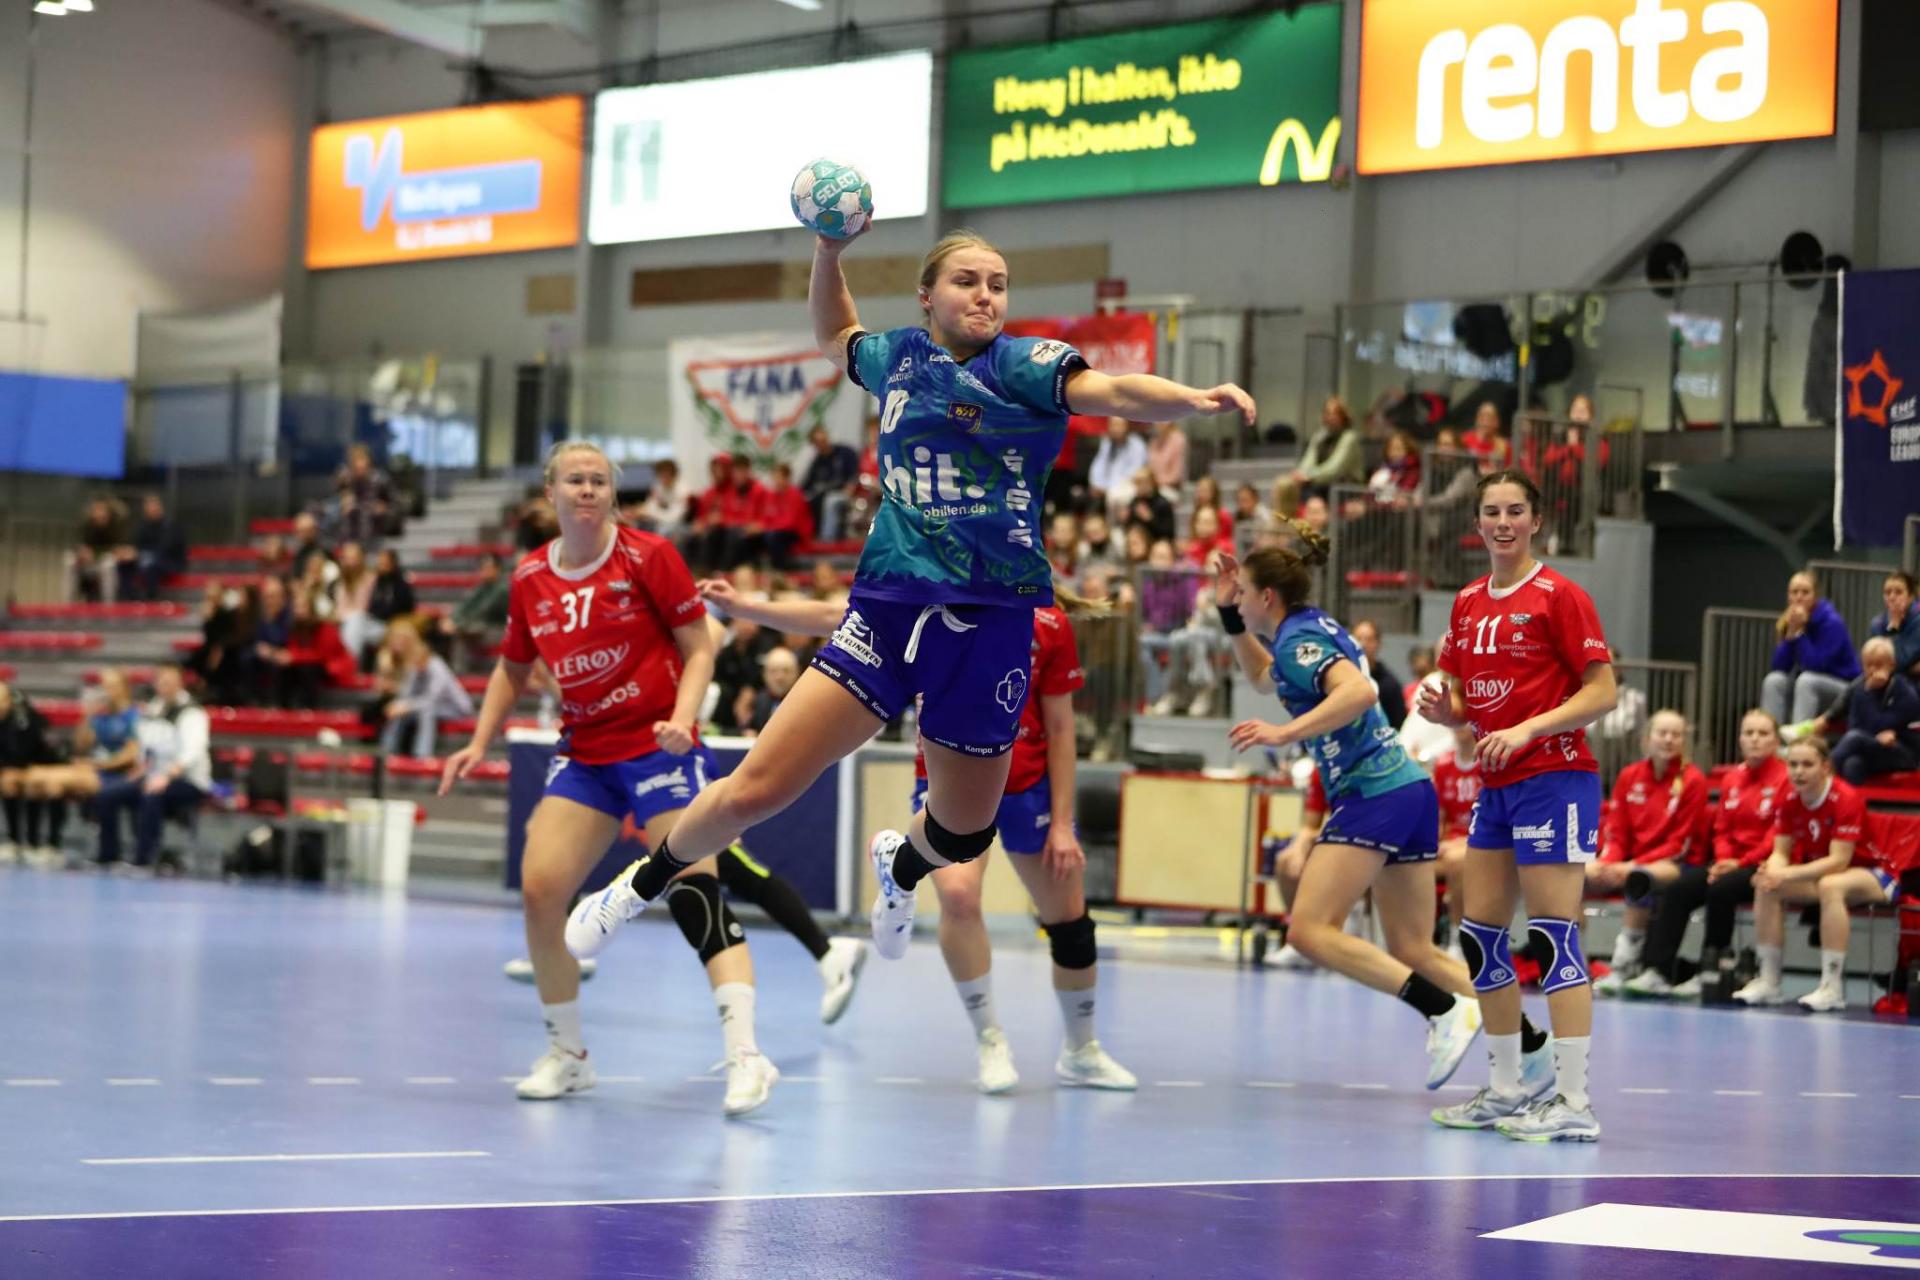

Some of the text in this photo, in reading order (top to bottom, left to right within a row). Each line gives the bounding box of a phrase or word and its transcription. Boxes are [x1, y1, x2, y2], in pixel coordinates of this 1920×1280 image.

[994, 53, 1241, 117] Heng i hallen, ikke
[1416, 0, 1768, 149] renta
[991, 108, 1197, 172] på McDonald's.
[816, 171, 859, 205] SELECT
[727, 366, 806, 396] FANA
[884, 446, 985, 504] hit.
[561, 586, 595, 633] 37
[844, 637, 881, 666] KLINIKEN
[1473, 615, 1503, 654] 11
[553, 645, 623, 680] LERØY
[819, 659, 841, 677] Kempa
[846, 679, 868, 701] Kempa
[965, 744, 993, 755] Kempa
[1808, 818, 1820, 842] 9
